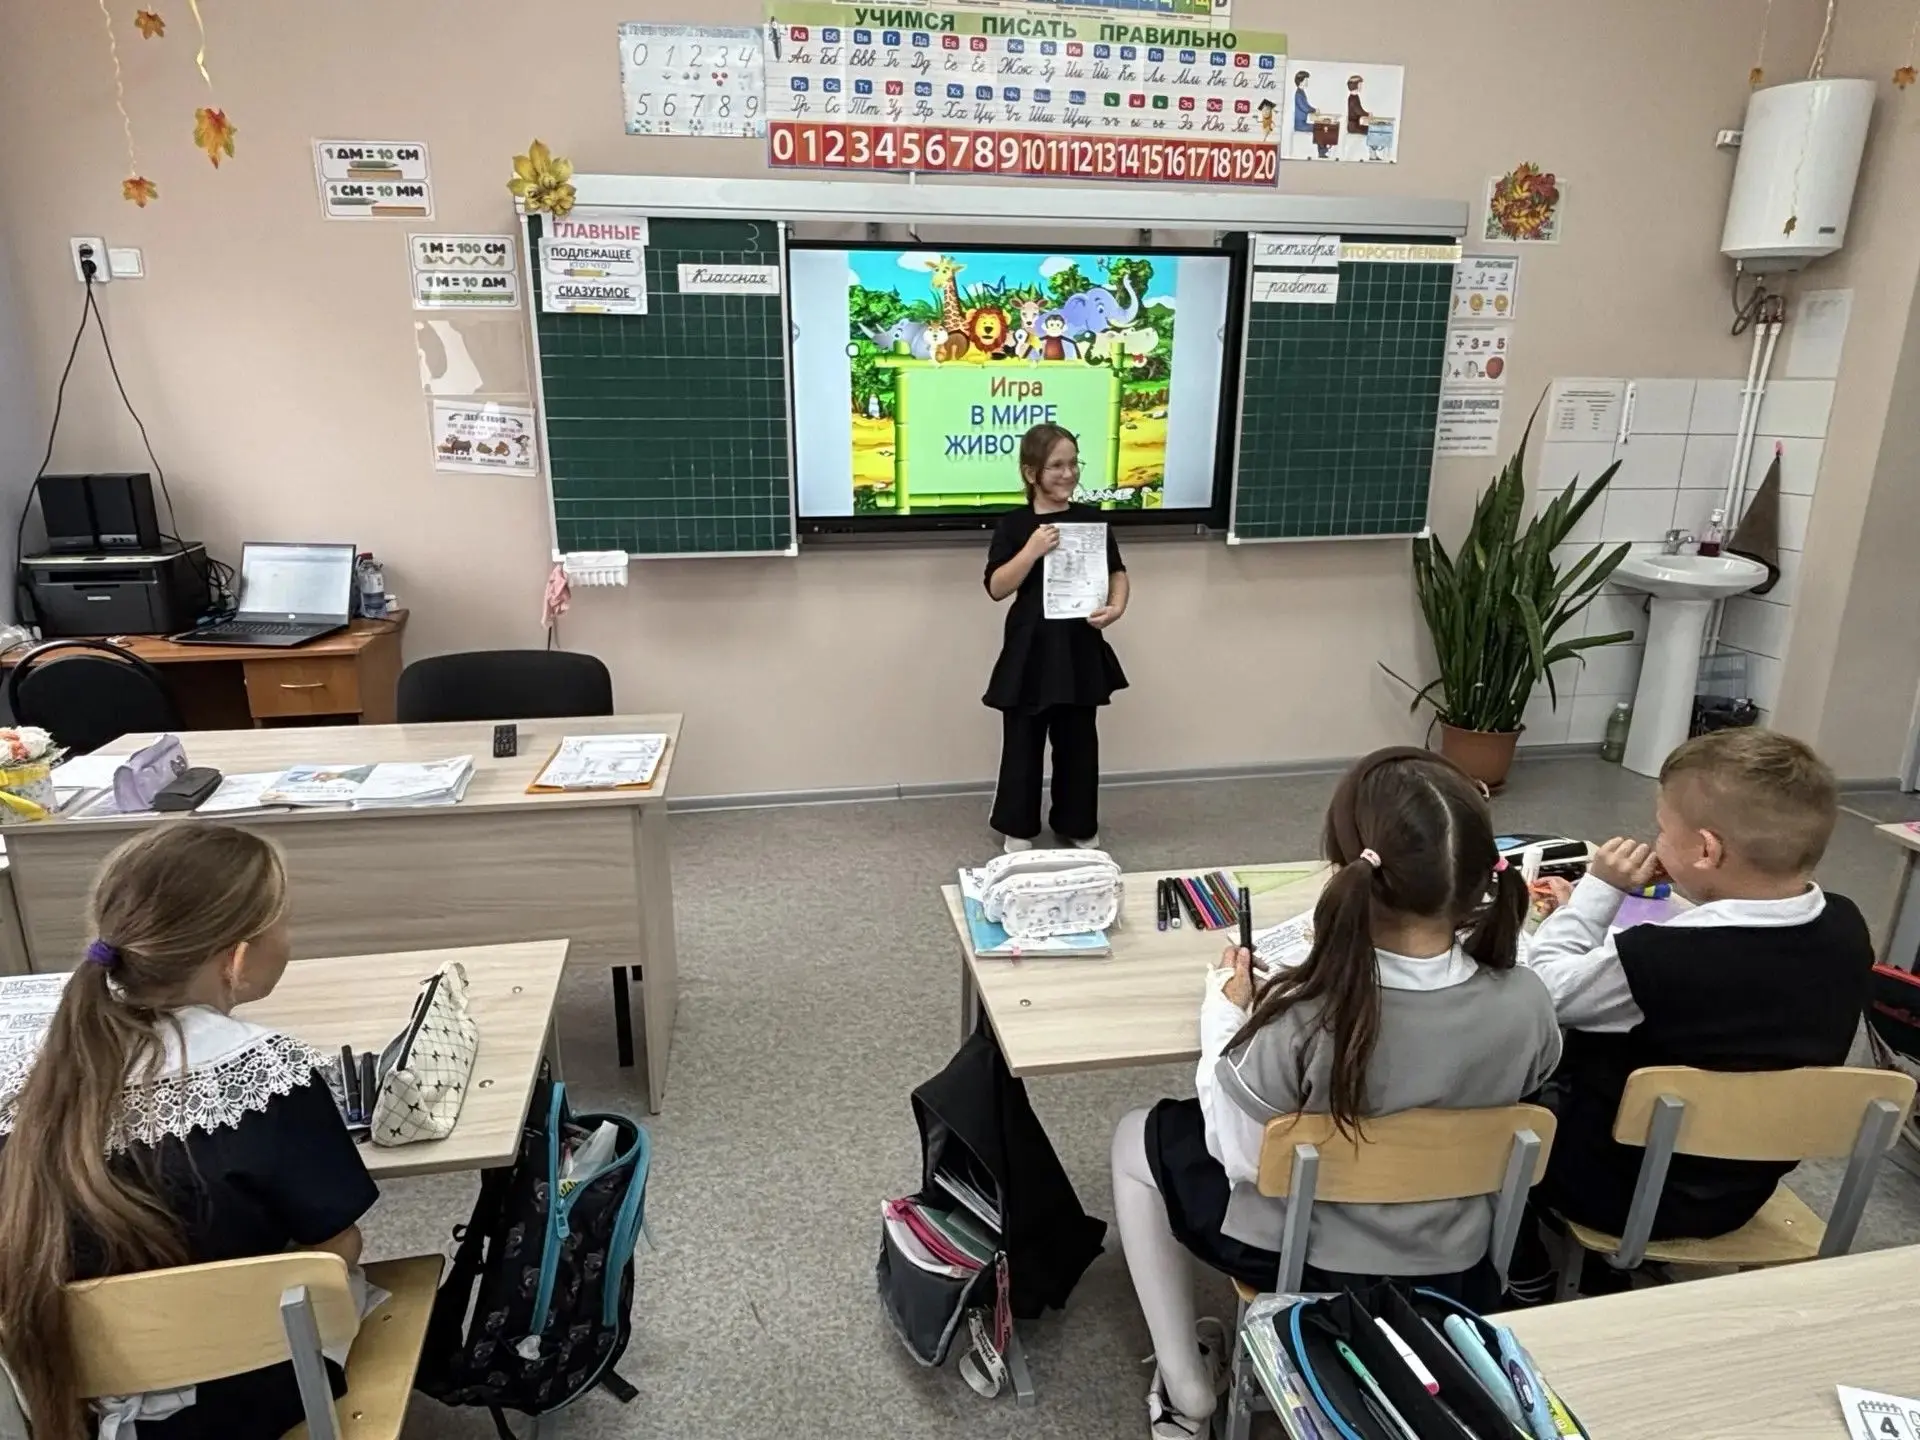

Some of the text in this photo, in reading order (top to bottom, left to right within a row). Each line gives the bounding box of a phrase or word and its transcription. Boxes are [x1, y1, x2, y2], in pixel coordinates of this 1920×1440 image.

[855, 8, 1237, 49] УЧИМСЯ ПИСАТЬ ПРАВИЛЬНО
[633, 43, 756, 69] 0 1 2 3 4
[788, 46, 811, 64] Аа
[1233, 71, 1249, 88] Оо
[636, 93, 759, 118] 5 6 7 8 9
[825, 96, 840, 113] Сс
[325, 148, 419, 161] 1 ДМ = 10 СМ
[773, 128, 1276, 180] 0 1 2 3 4 5 6 7 8 9 10 11 12 13 14 15 16 17 18 19 20
[329, 185, 424, 197] 1 СМ = 10 ММ
[552, 222, 641, 241] ГЛАВНЫЕ
[743, 222, 760, 254] 3
[420, 242, 506, 254] 1 М = 100 СМ
[551, 247, 633, 261] ПОДЛЕЖАЩЕЕ
[1266, 233, 1337, 265] октября
[425, 276, 508, 288] 1 М = 10 ДМ
[692, 268, 768, 285] Классная
[1265, 273, 1329, 300] работа
[1475, 271, 1487, 285] 3
[1498, 272, 1509, 286] 2
[558, 285, 631, 299] СКАЗУЕМОЕ
[1470, 338, 1480, 350] 3
[1496, 338, 1506, 350] 5
[991, 376, 1043, 402] Игра
[971, 404, 1058, 426] В МИРЕ
[1880, 1416, 1900, 1438] 4
